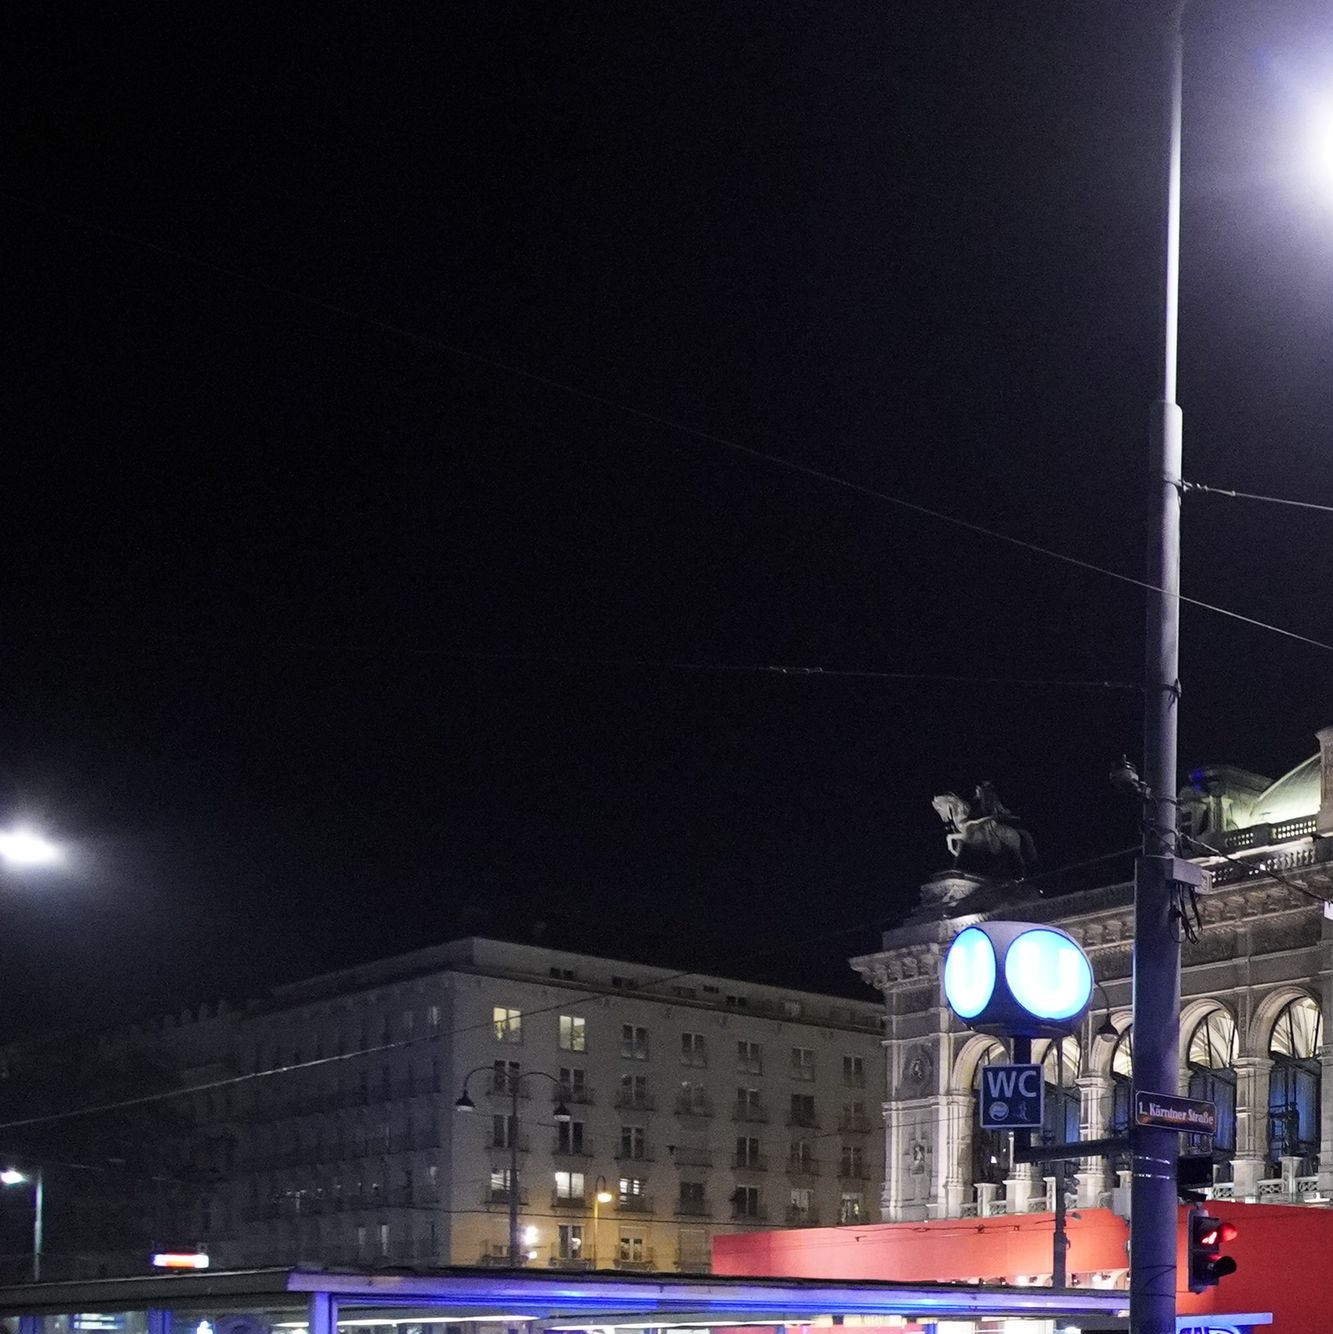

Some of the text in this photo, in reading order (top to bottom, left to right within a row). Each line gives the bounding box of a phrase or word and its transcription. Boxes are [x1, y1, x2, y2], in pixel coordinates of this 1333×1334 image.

[987, 1071, 1037, 1098] WC
[1149, 1102, 1187, 1121] Kärntner
[1188, 1108, 1214, 1125] Straße
